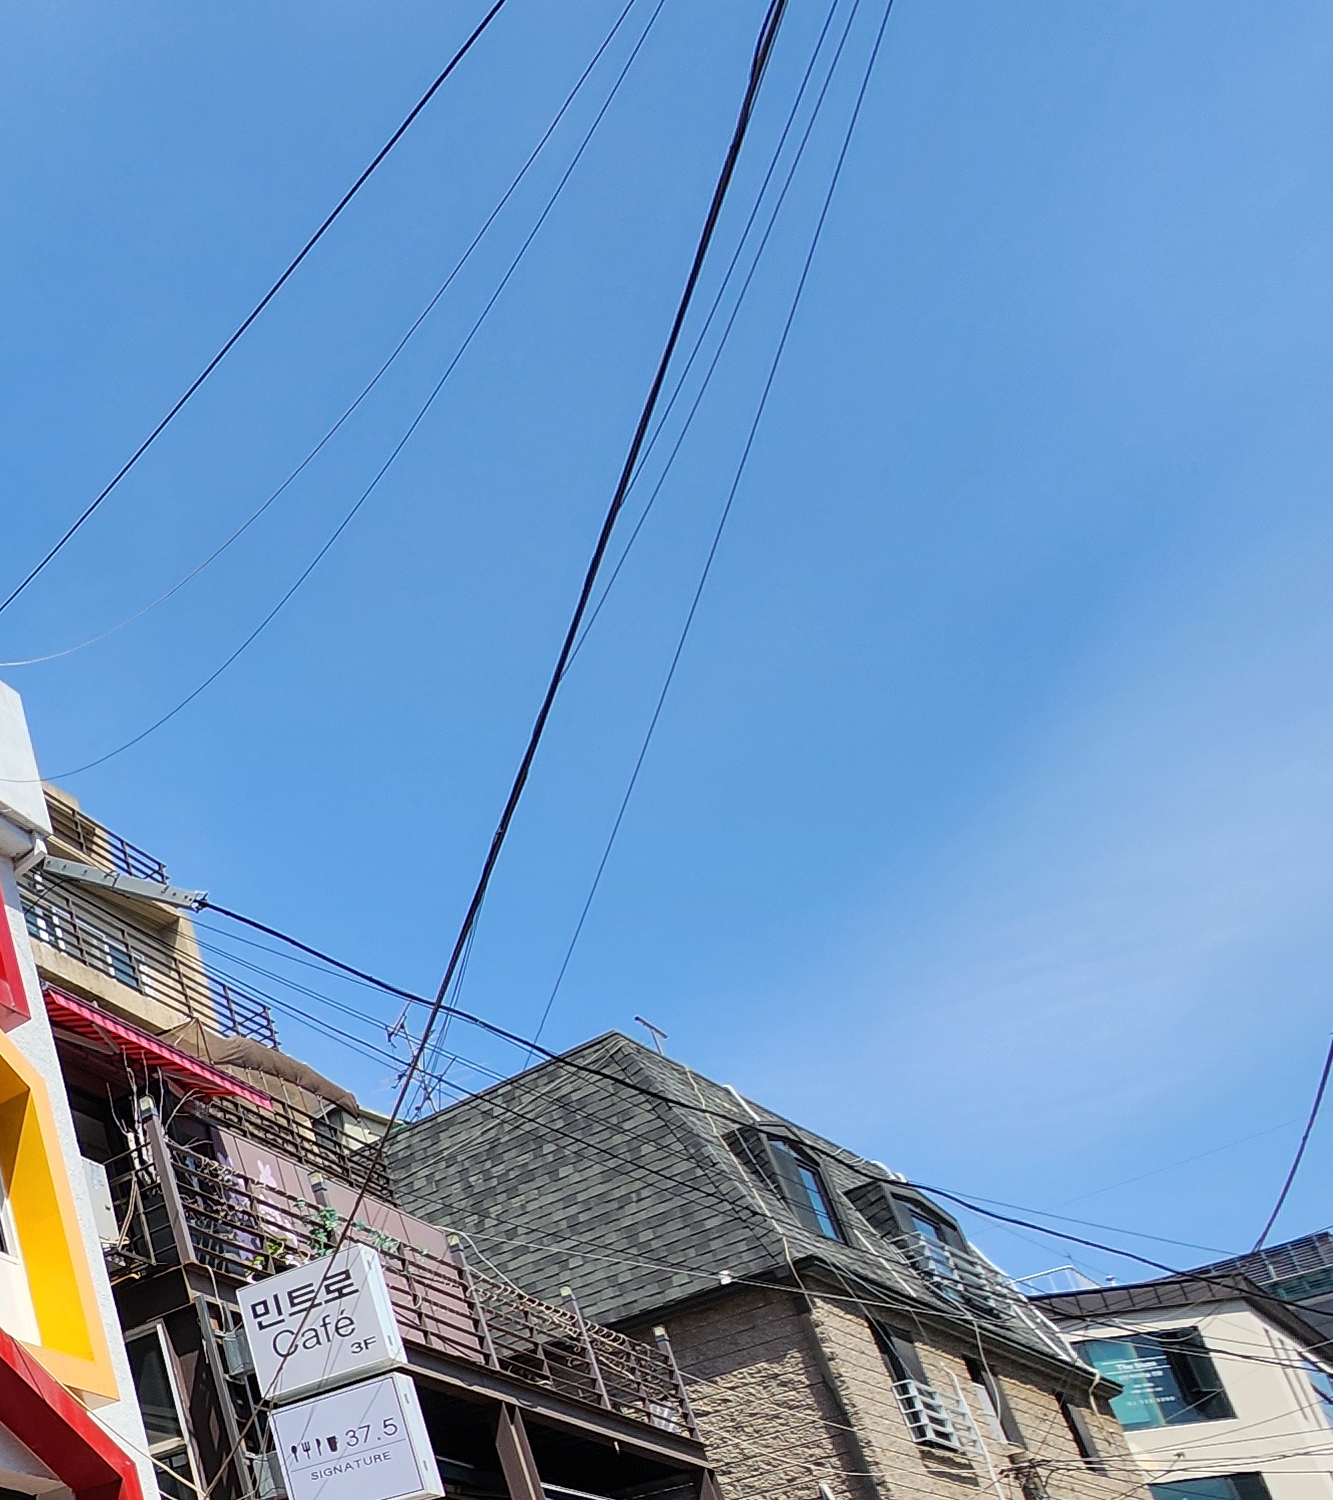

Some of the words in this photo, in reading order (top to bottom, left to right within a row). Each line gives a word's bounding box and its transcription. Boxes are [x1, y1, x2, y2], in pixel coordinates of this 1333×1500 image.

[250, 1268, 360, 1331] 민트로
[272, 1308, 356, 1359] Café
[350, 1336, 377, 1354] 3F
[345, 1417, 398, 1448] 37.5
[310, 1451, 392, 1481] SIGNATURE
